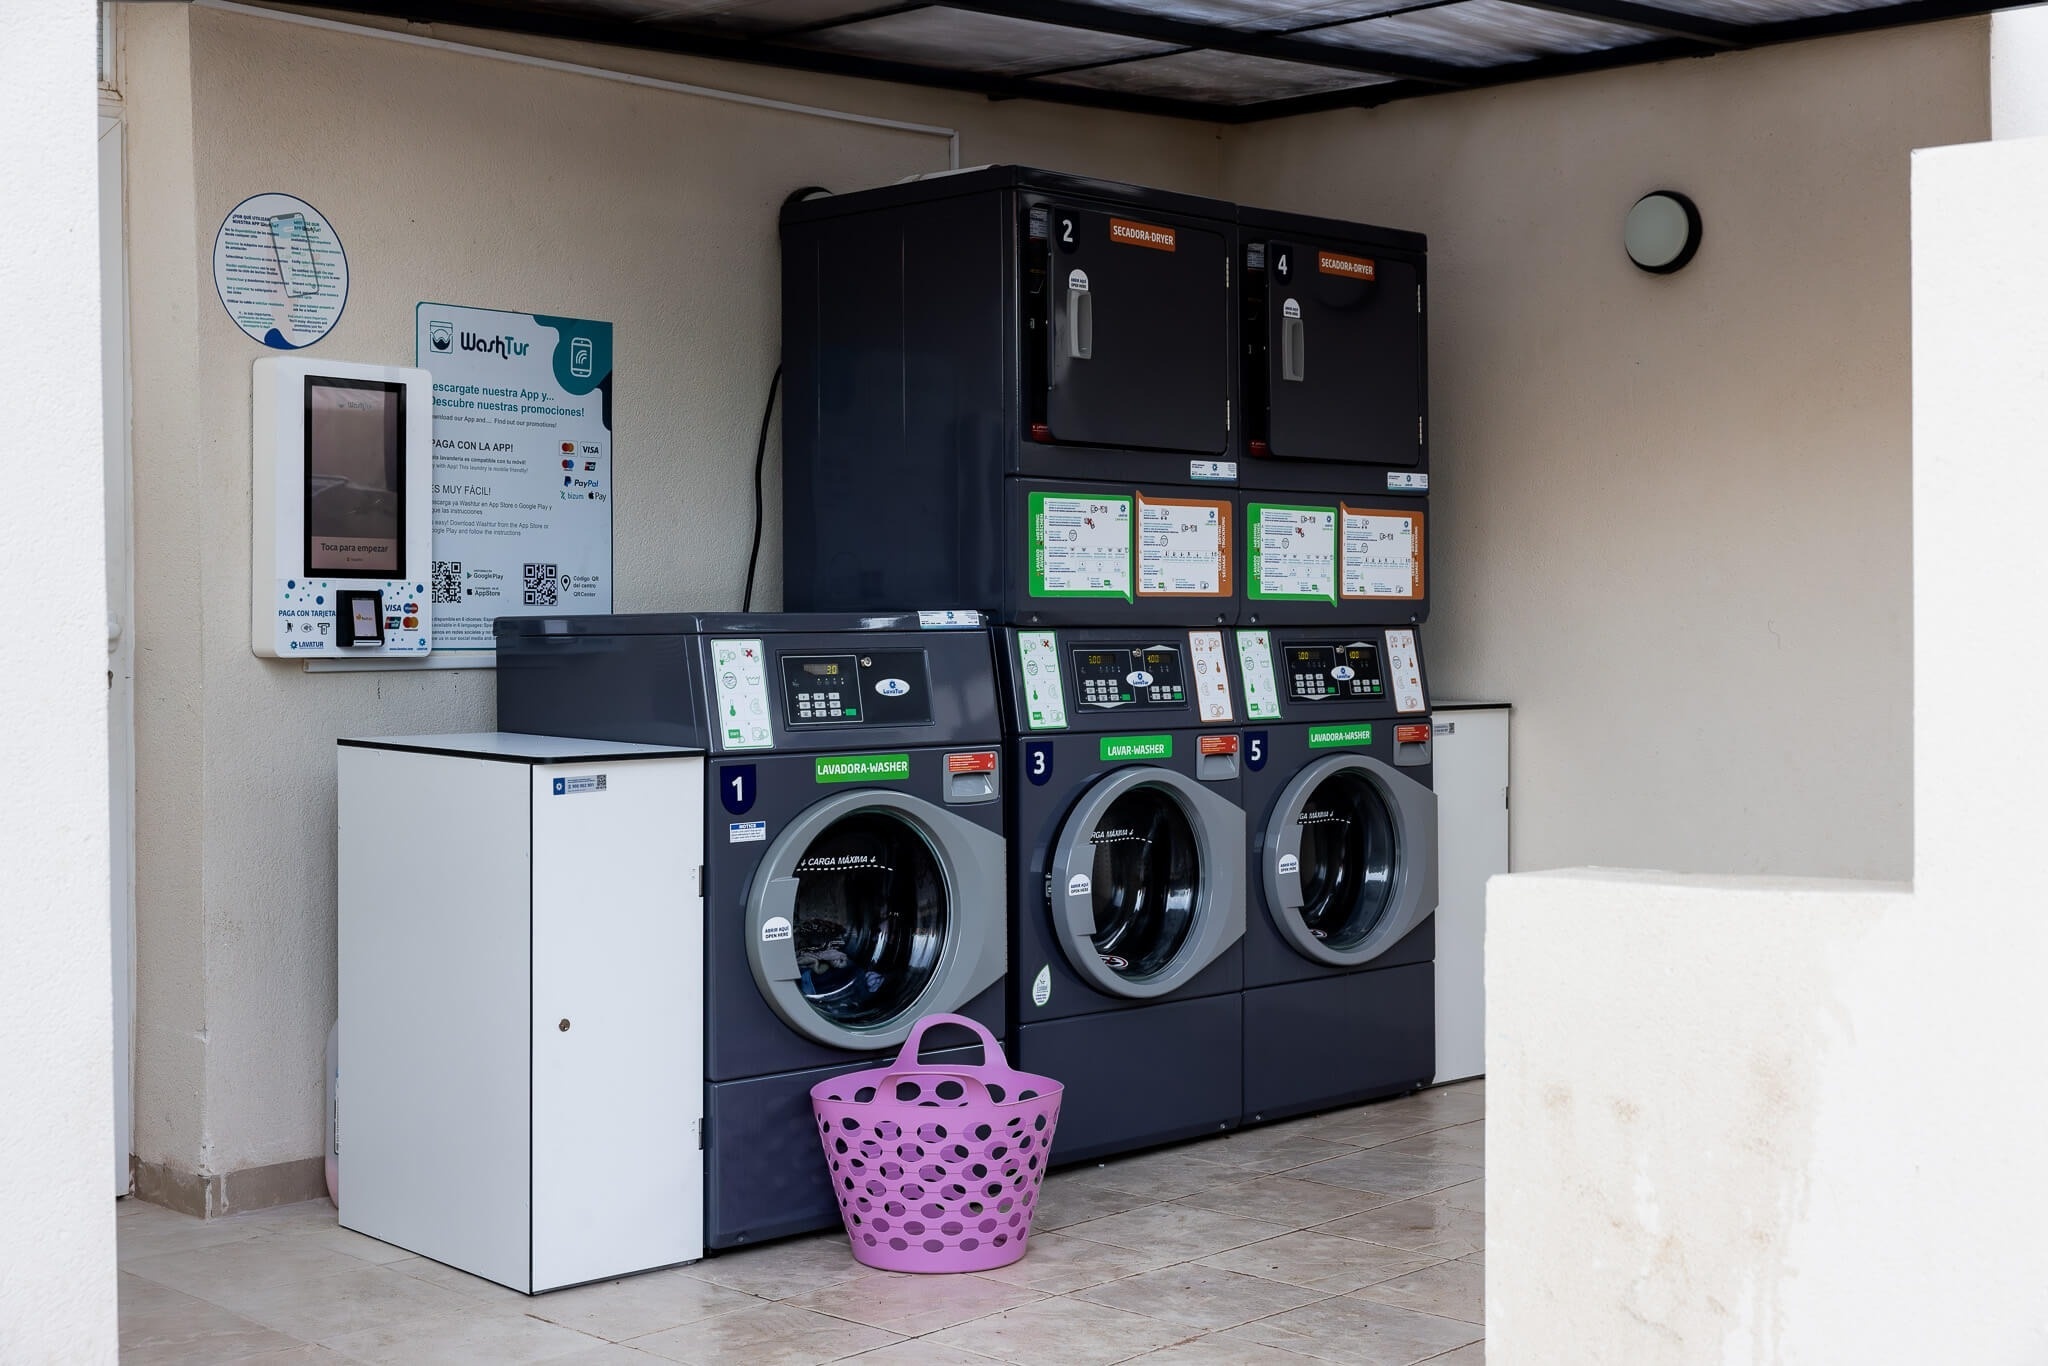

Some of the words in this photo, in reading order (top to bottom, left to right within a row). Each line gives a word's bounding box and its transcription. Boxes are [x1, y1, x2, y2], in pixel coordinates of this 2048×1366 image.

[1062, 219, 1073, 243] 2
[1113, 225, 1174, 246] SECADORA-DRYER
[1278, 254, 1287, 275] 4
[1321, 257, 1373, 275] SECADORA-DRYER
[461, 332, 529, 360] WashTur
[432, 383, 480, 396] escargate
[482, 387, 518, 398] nuestra
[520, 388, 540, 401] App
[476, 401, 519, 412] nuestras
[521, 404, 585, 418] promociones!
[464, 416, 474, 424] App
[457, 440, 477, 452] CON
[479, 442, 491, 452] LA
[492, 443, 514, 453] APP!
[582, 446, 602, 454] VISA
[574, 479, 599, 488] PayPal
[442, 484, 462, 494] MUY
[464, 485, 491, 496] FÁCIL!
[568, 492, 584, 500] bizum
[594, 492, 607, 503] Pay
[518, 503, 536, 511] Google
[538, 503, 548, 511] Play
[446, 528, 457, 536] Play
[519, 522, 529, 530] App
[320, 542, 338, 552] Toca
[356, 545, 388, 554] empezar
[384, 604, 402, 612] VISA
[311, 610, 336, 619] TARJETA
[826, 665, 837, 675] 30
[1310, 731, 1370, 743] LAVADORA-WASHER
[1108, 744, 1164, 757] LAVAR-WASHER
[1251, 740, 1260, 761] 5
[817, 760, 908, 776] LAVADORA-WASHER
[1033, 751, 1045, 775] 3
[731, 776, 743, 802] 1
[808, 858, 836, 866] CARGA
[838, 856, 868, 864] MÁXIMA
